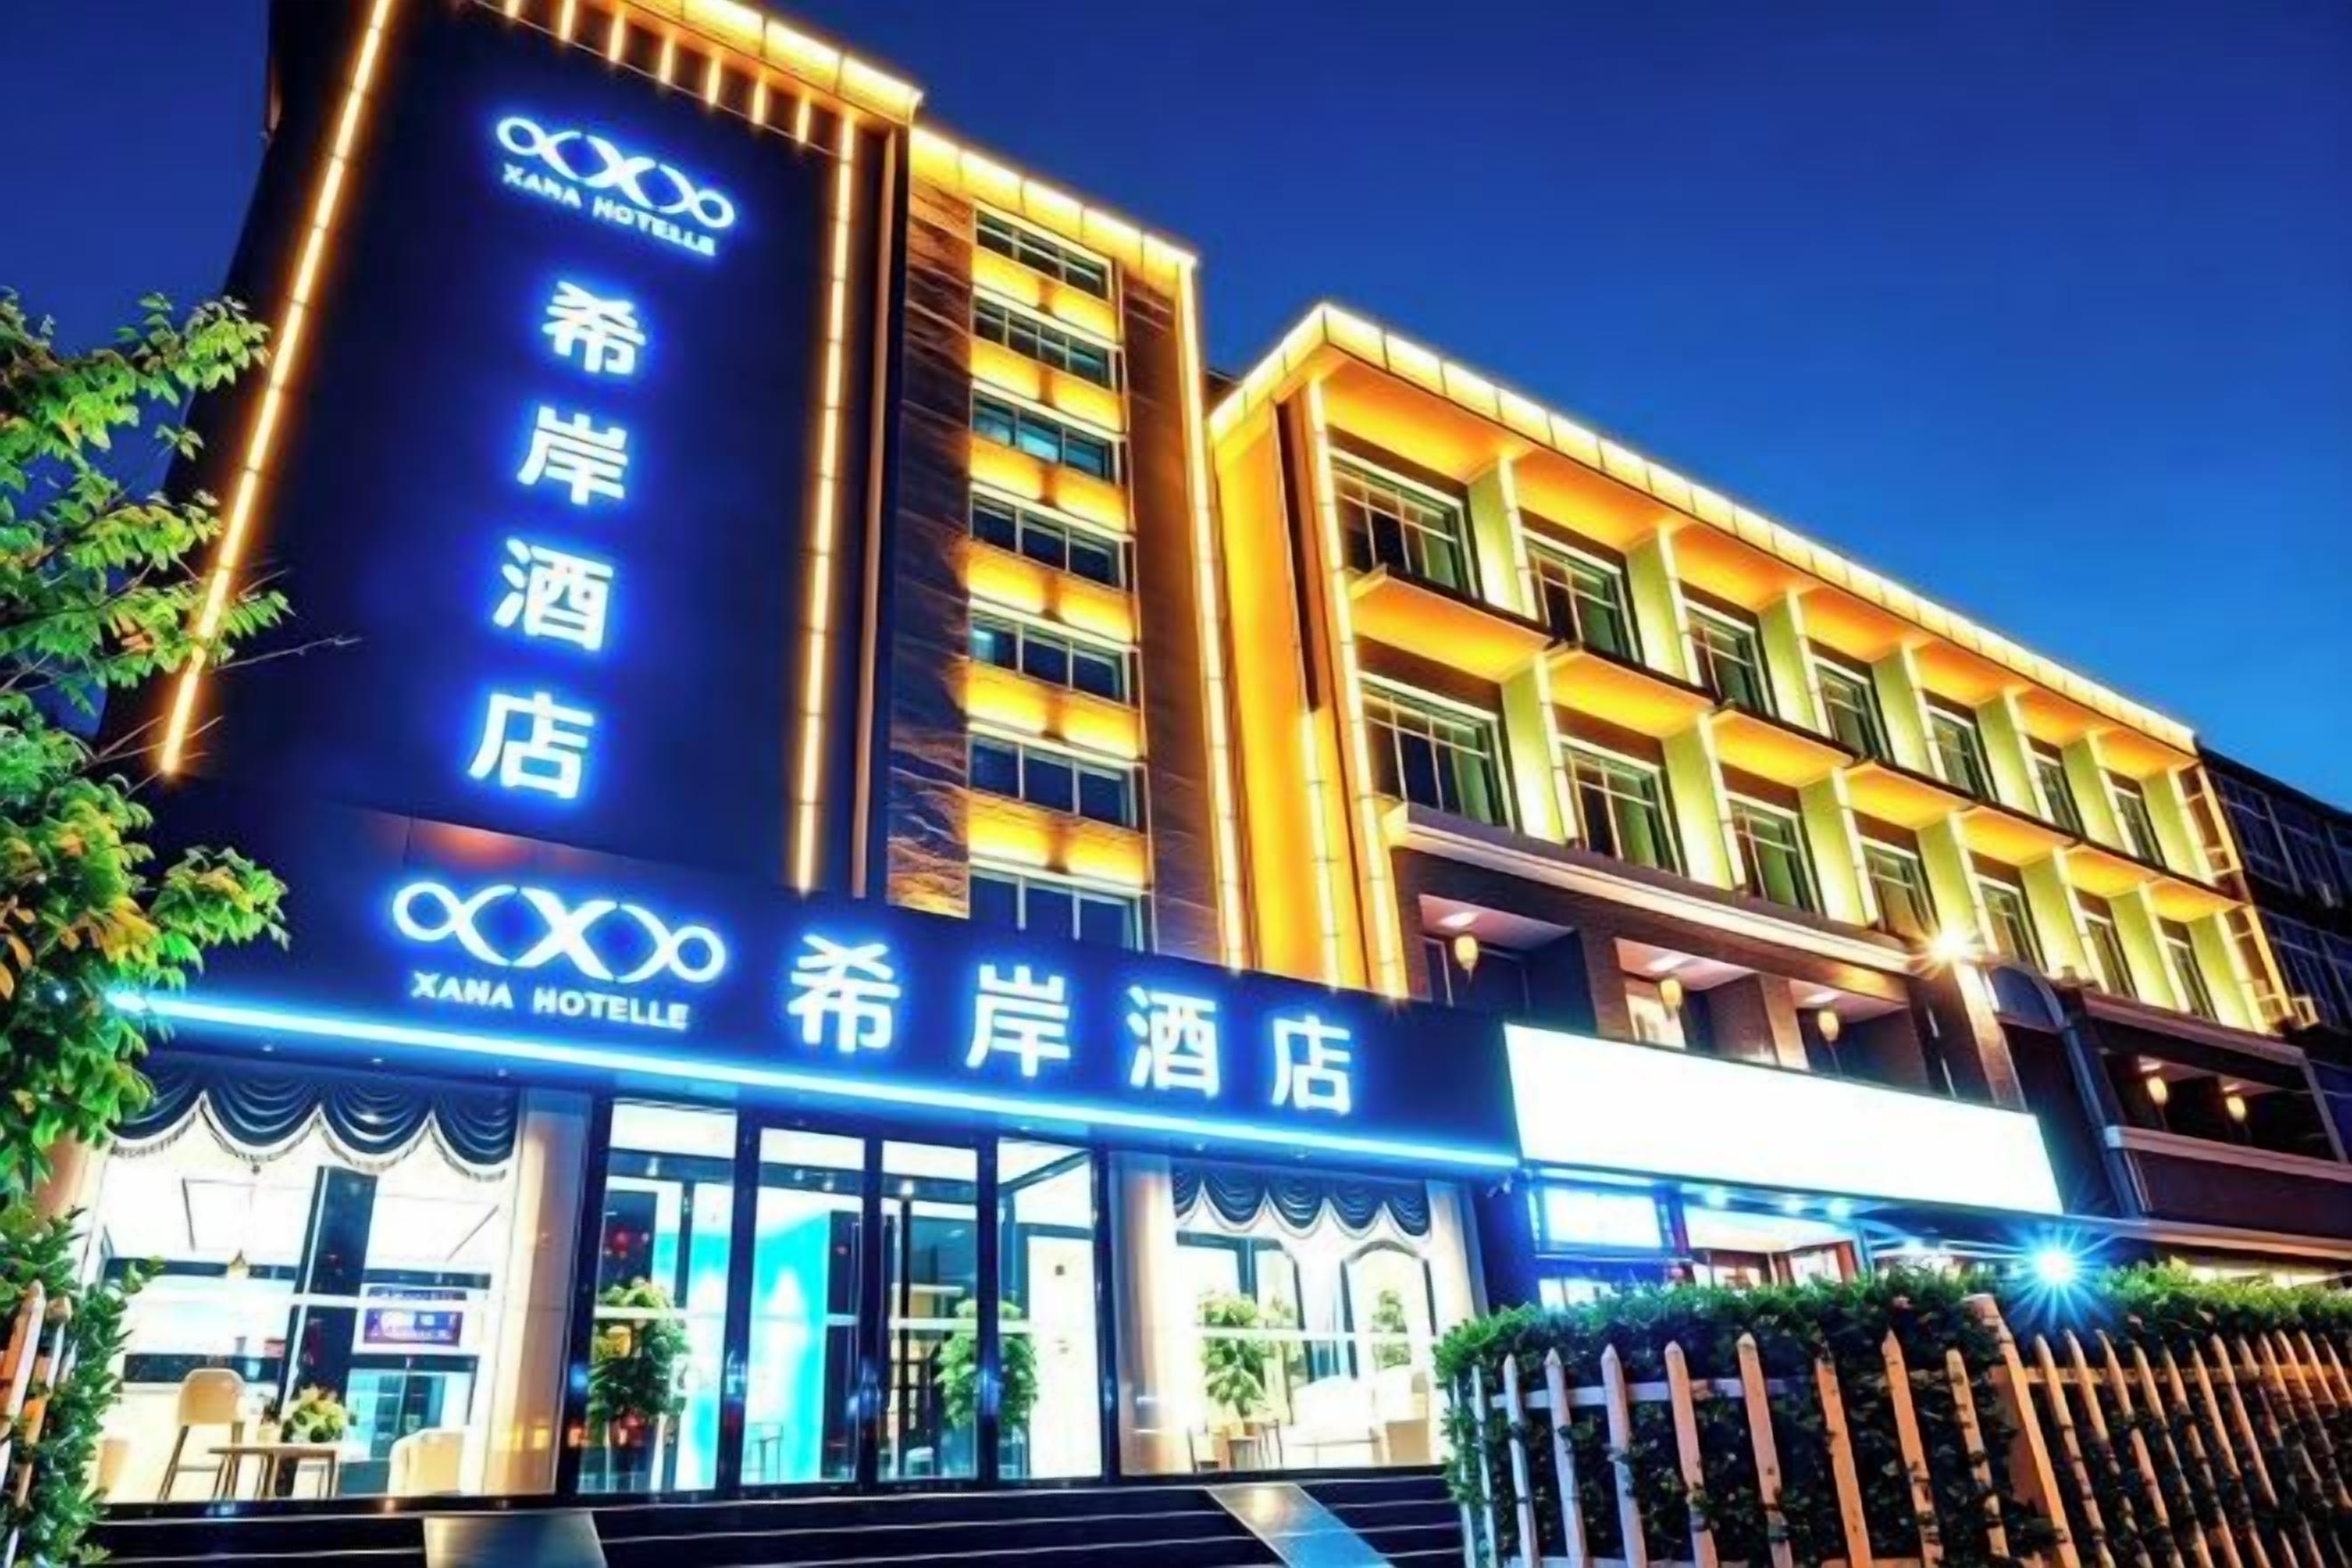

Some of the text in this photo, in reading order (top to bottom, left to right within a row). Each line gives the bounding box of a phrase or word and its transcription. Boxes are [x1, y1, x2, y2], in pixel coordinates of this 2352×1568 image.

[592, 196, 715, 256] HOTELLE
[468, 281, 646, 799] 希岸酒店
[412, 971, 690, 1031] XANA HOTELLE
[788, 935, 1352, 1115] 希岸酒店
